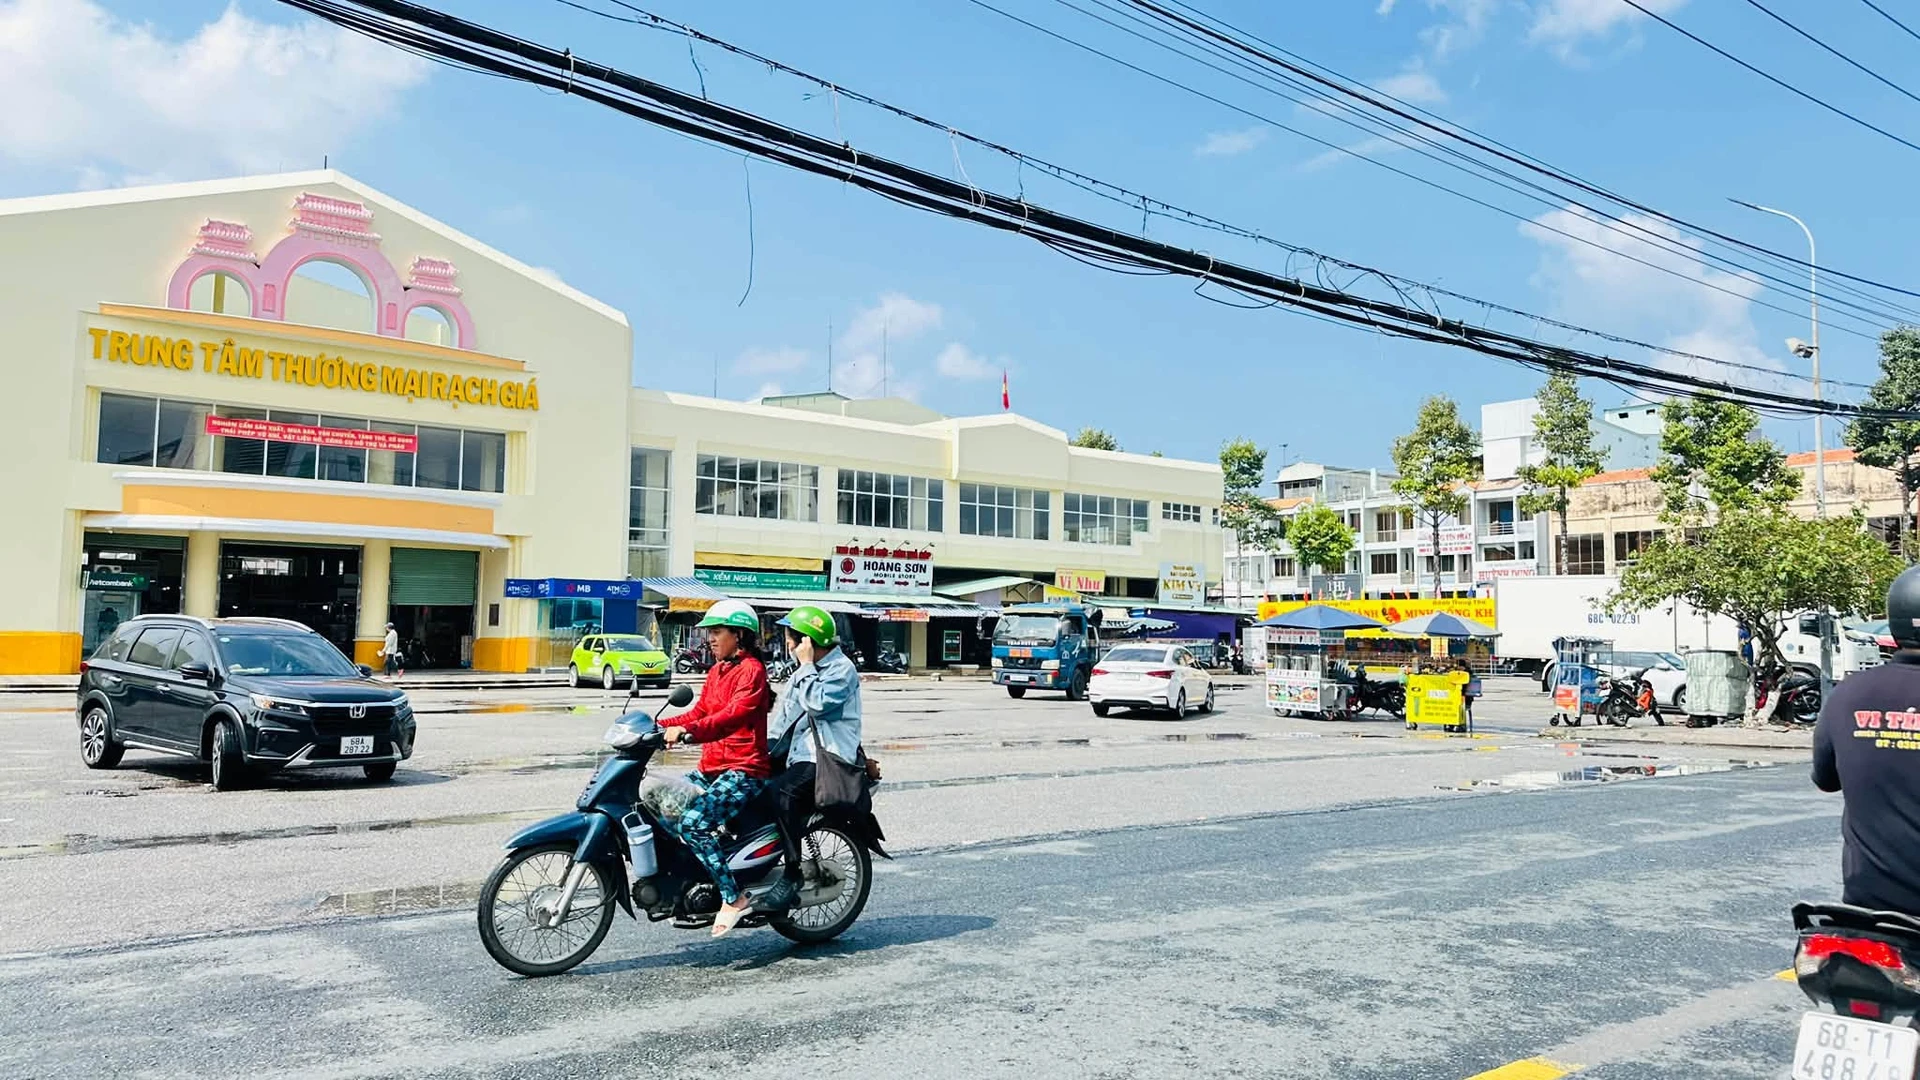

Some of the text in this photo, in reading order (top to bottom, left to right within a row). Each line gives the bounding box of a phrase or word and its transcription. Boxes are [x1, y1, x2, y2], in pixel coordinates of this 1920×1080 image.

[89, 328, 540, 411] TRUNG TÂM THƯƠNG MẠI RẠCH GIÁ
[904, 563, 927, 574] SƠN
[1060, 575, 1071, 589] Vi
[1163, 579, 1186, 591] KIM
[576, 584, 591, 593] MB
[606, 585, 620, 593] ATM
[1587, 613, 1604, 624] 68C
[1854, 711, 1881, 729] VI
[350, 737, 365, 746] 68A
